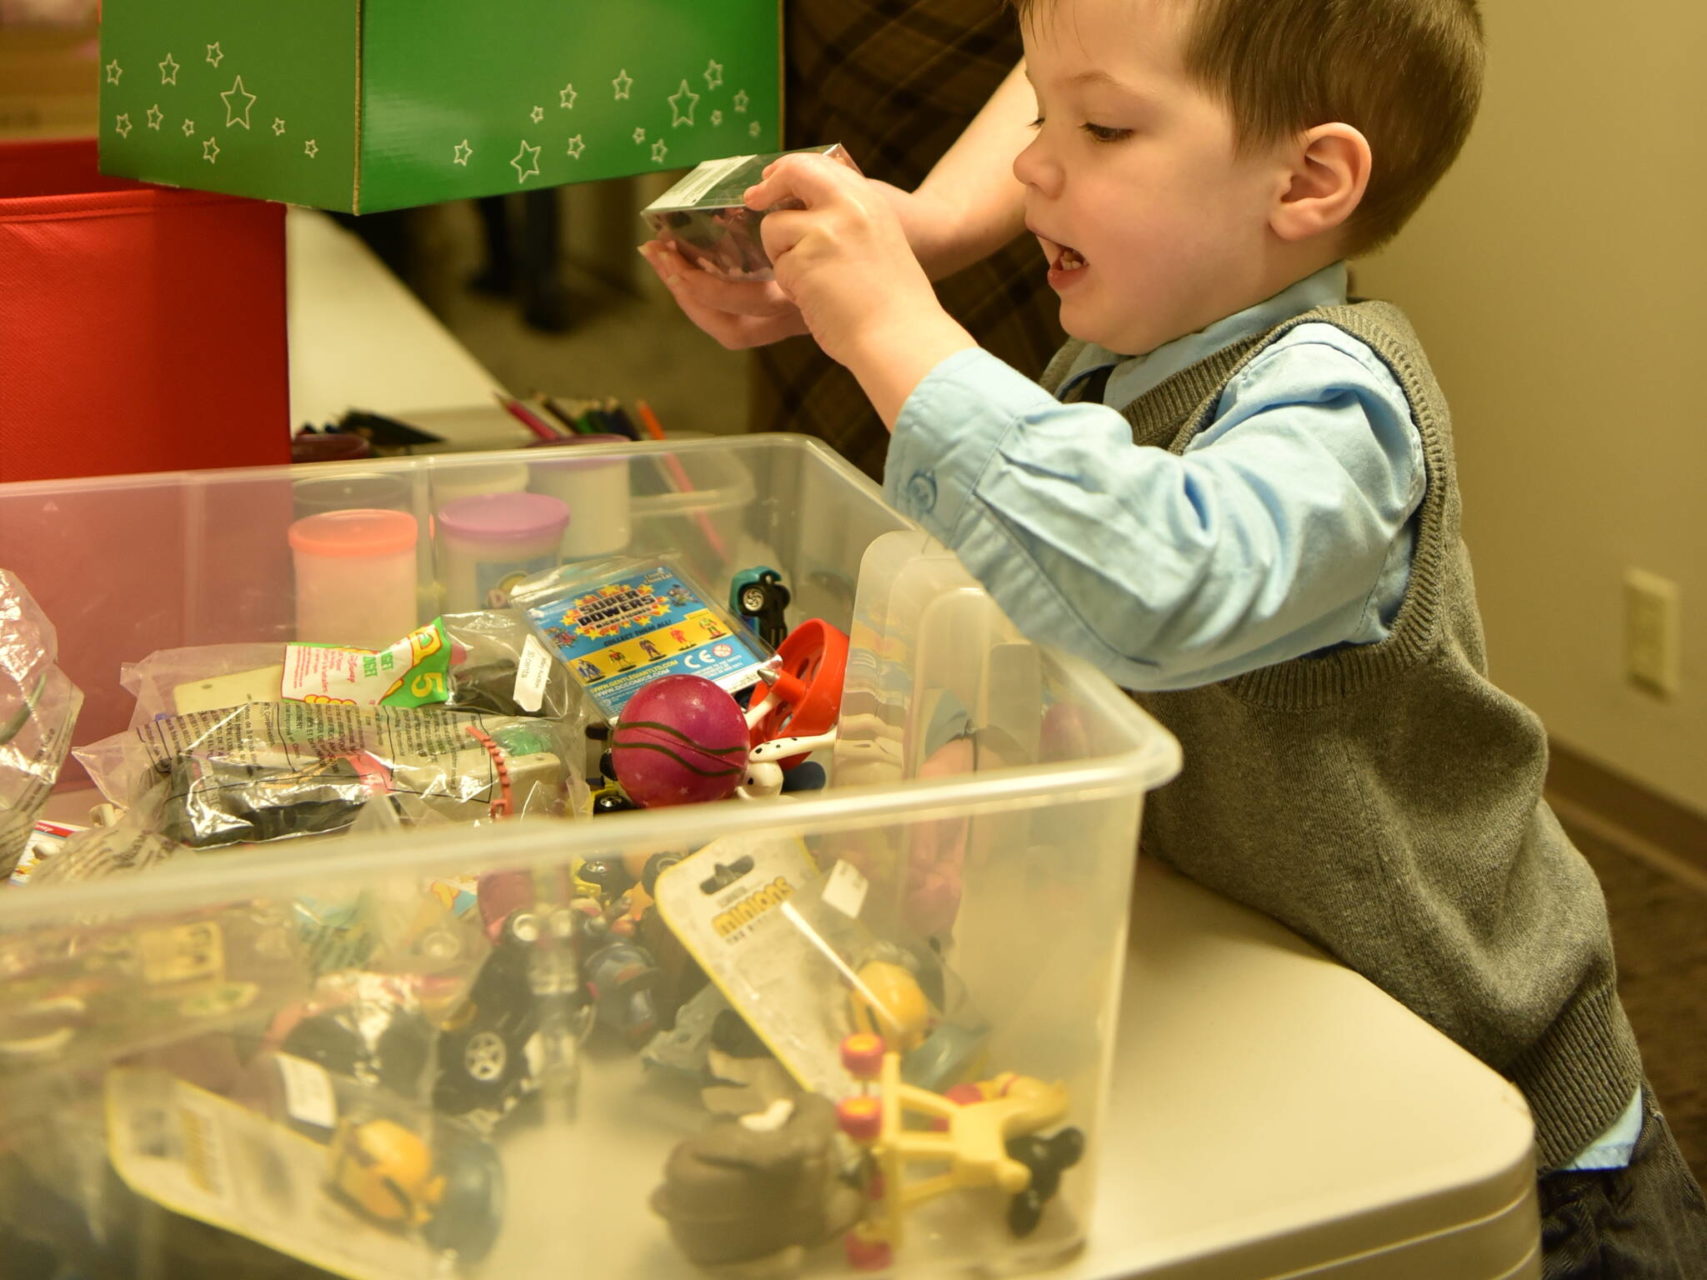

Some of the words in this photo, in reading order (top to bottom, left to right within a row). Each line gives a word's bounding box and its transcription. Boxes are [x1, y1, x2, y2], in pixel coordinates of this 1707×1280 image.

[577, 594, 656, 626] POWERS
[579, 589, 639, 616] SUPER
[411, 672, 443, 698] 5
